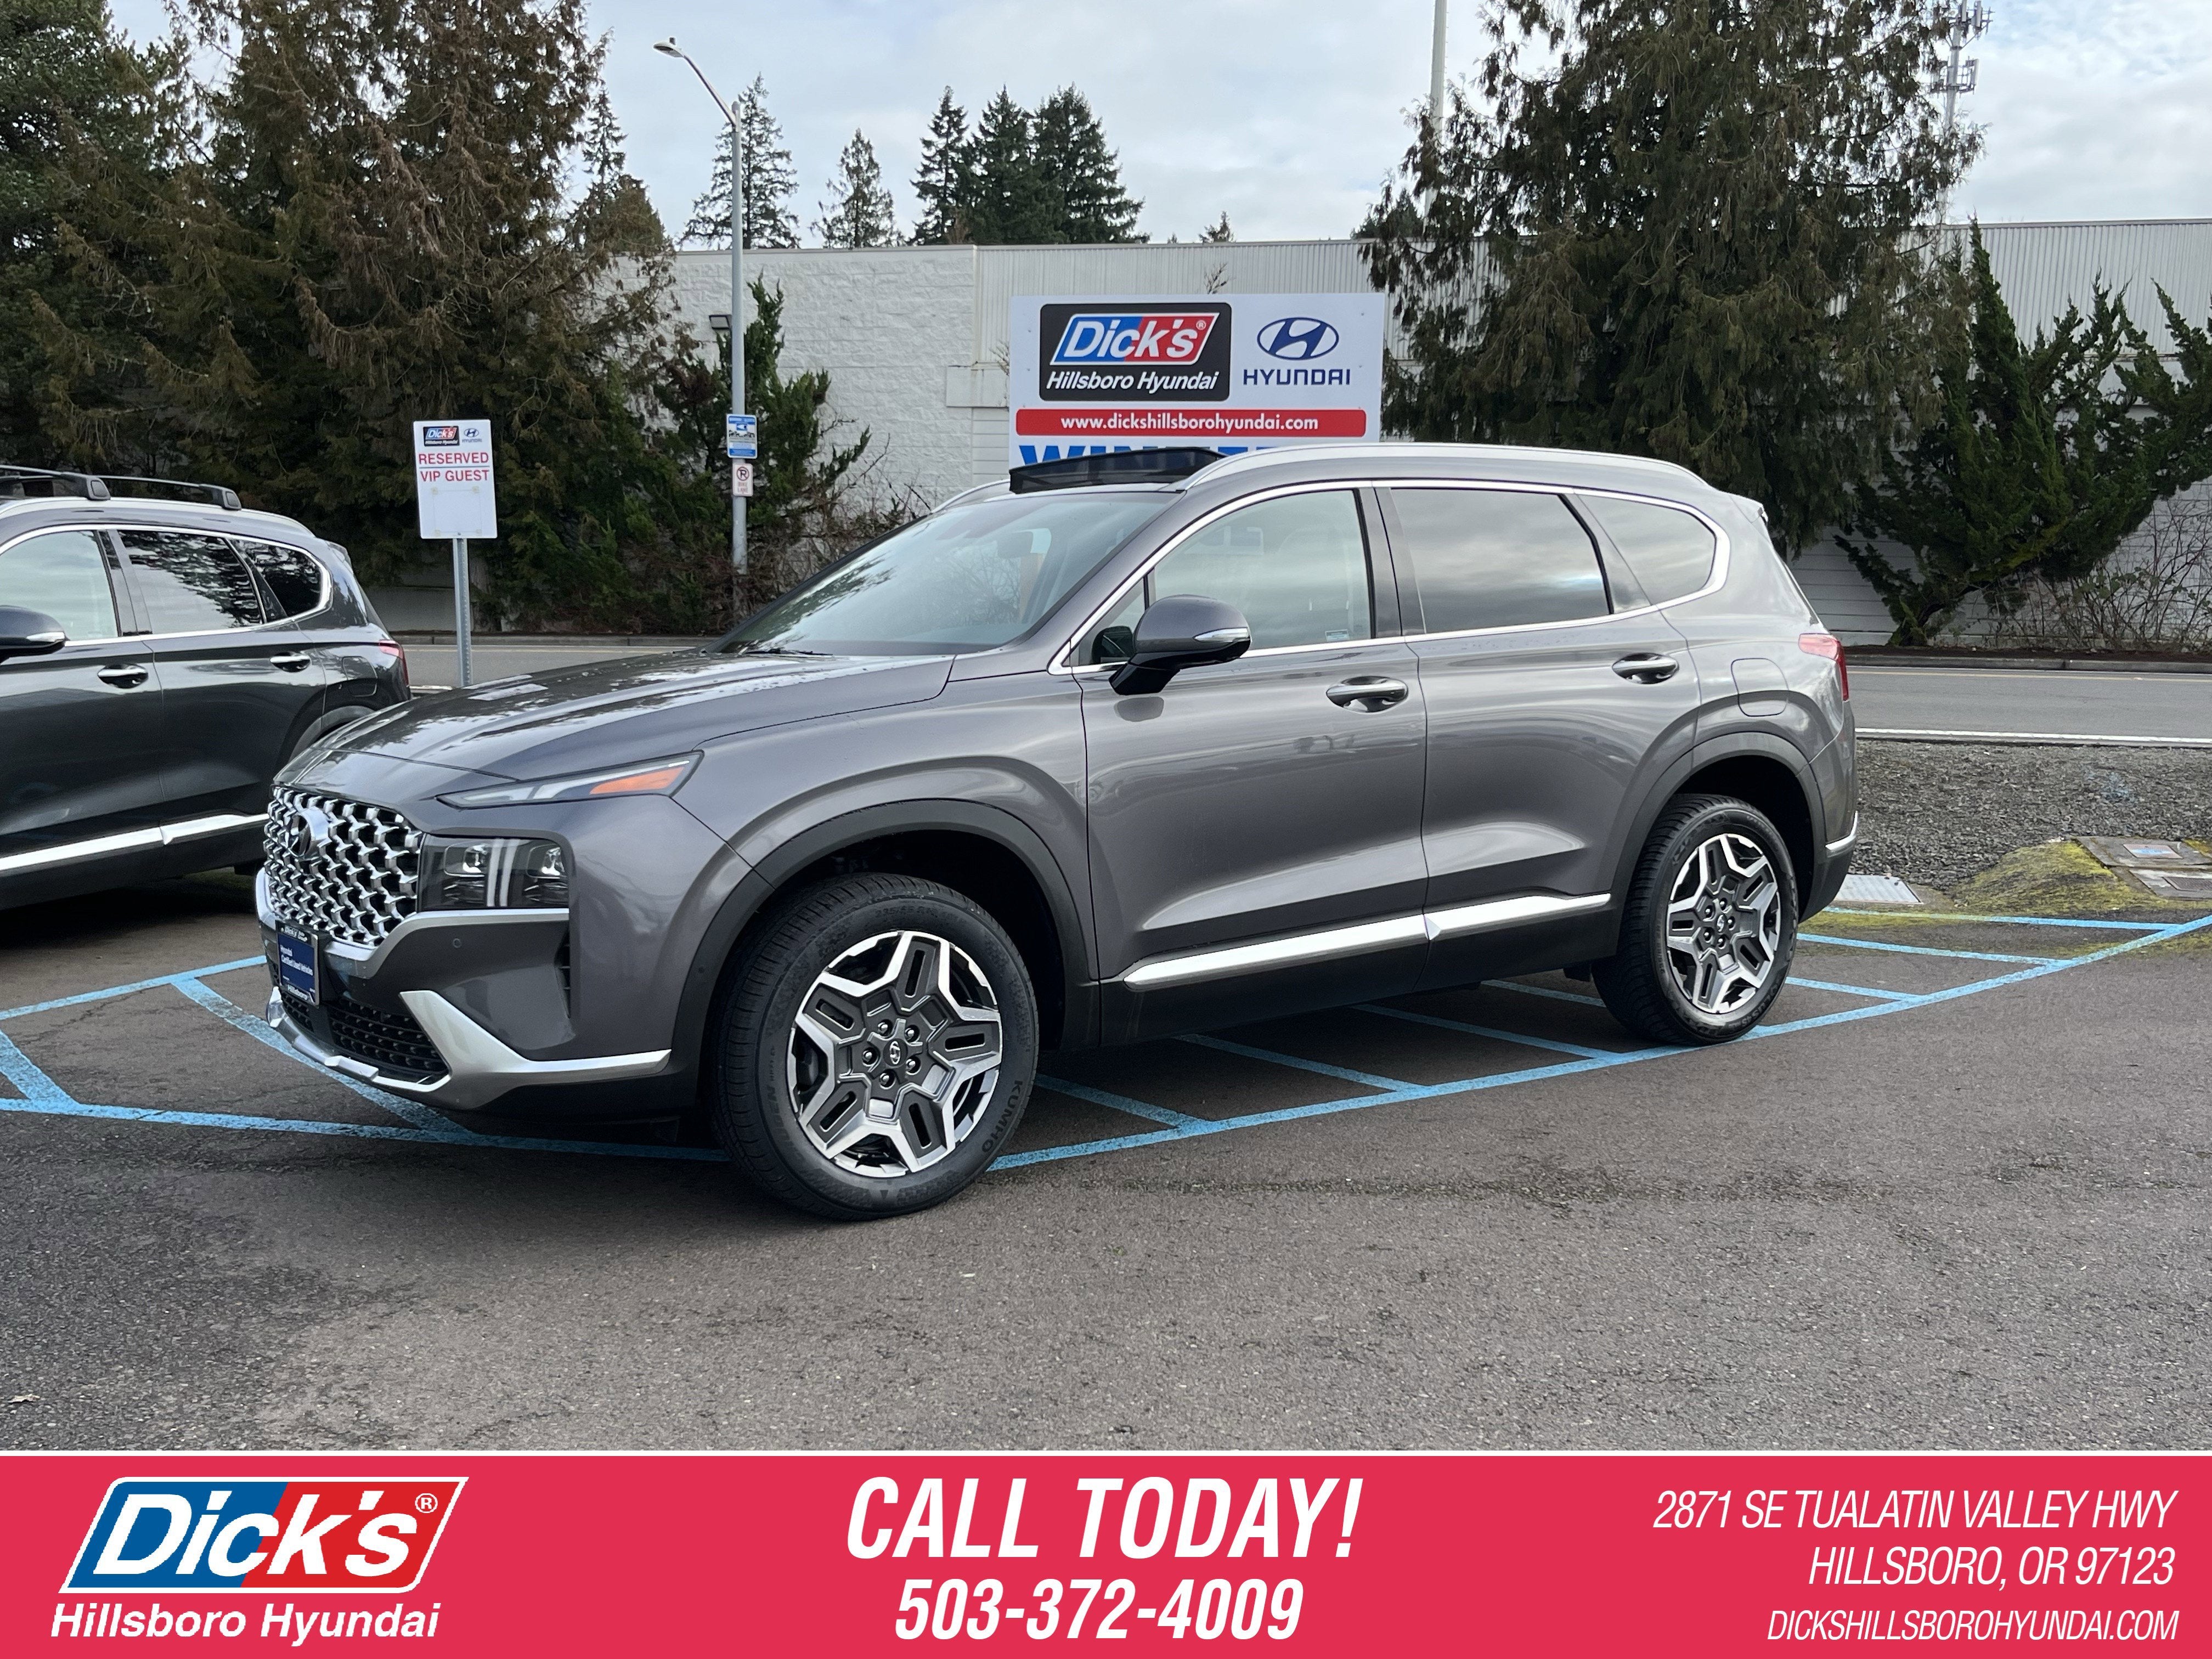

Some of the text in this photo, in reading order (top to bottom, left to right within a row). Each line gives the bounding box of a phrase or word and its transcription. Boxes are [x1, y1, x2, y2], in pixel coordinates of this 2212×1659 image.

[1063, 319, 1198, 358] Dick's
[1046, 371, 1220, 394] Hillsboro Hyundai
[1243, 369, 1351, 386] HYUNDAI
[1061, 413, 1319, 433] www.dickshillsborohyundai.com
[419, 452, 489, 464] RESERVED
[420, 470, 490, 482] VIP GUEST
[981, 1080, 1024, 1153] KUMHO
